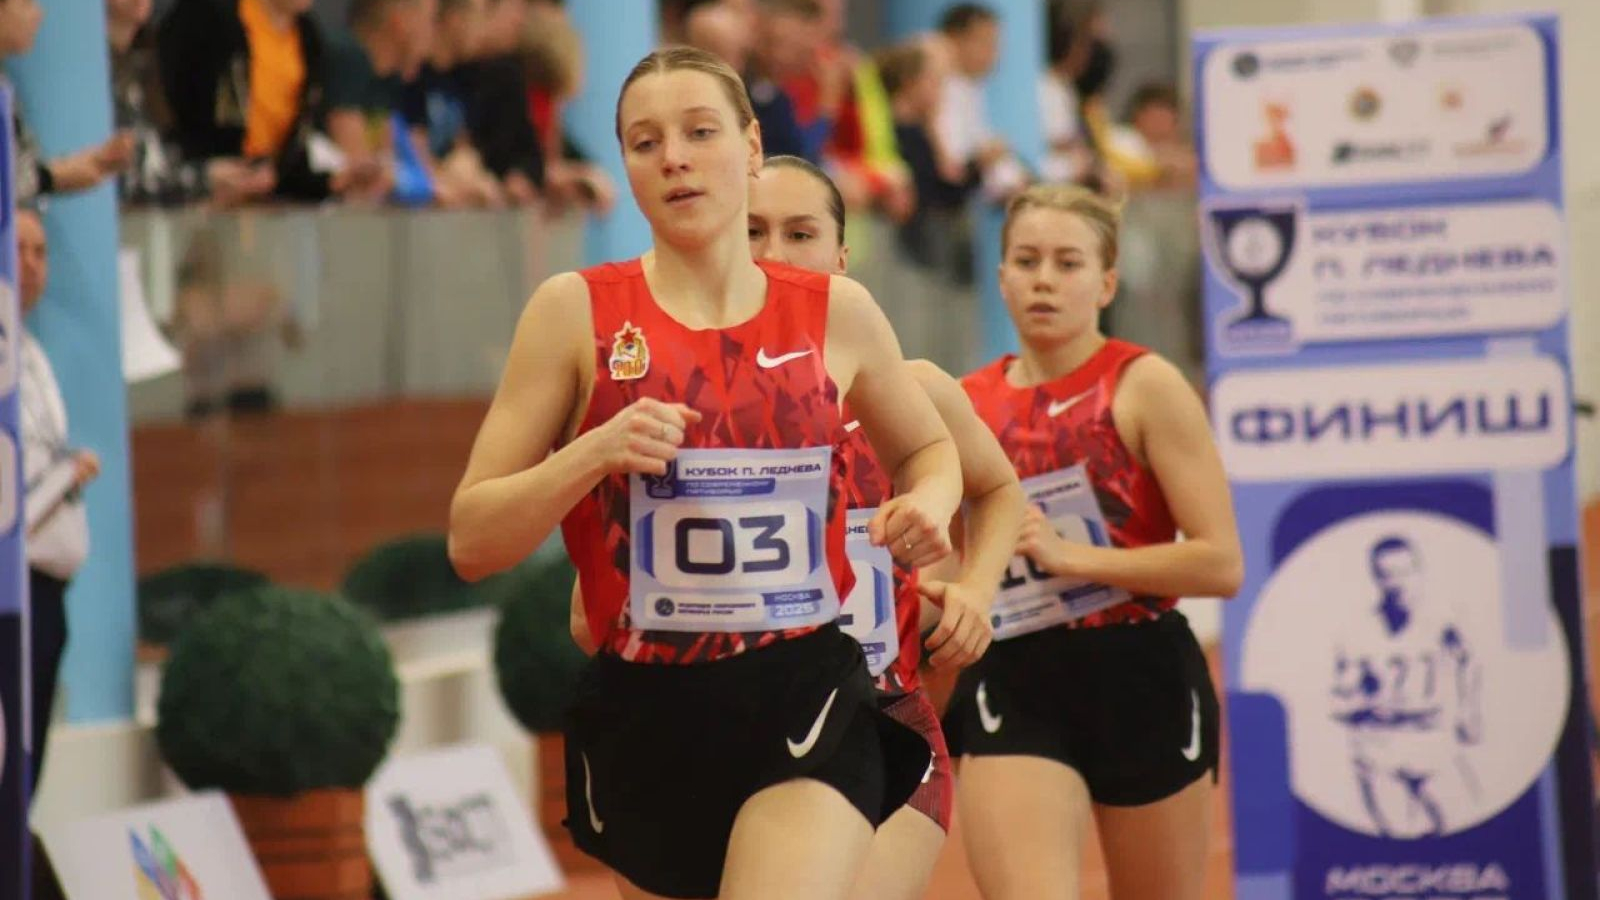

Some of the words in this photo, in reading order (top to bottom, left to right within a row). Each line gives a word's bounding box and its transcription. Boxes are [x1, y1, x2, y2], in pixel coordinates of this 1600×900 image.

[1230, 393, 1551, 443] ФИНИШ
[685, 467, 738, 477] КУБОК
[742, 467, 755, 476] П.
[759, 463, 821, 475] ЛЕДНЕВА
[675, 514, 790, 575] 03
[774, 603, 815, 616] 2025
[1325, 862, 1510, 895] МОСКВА
